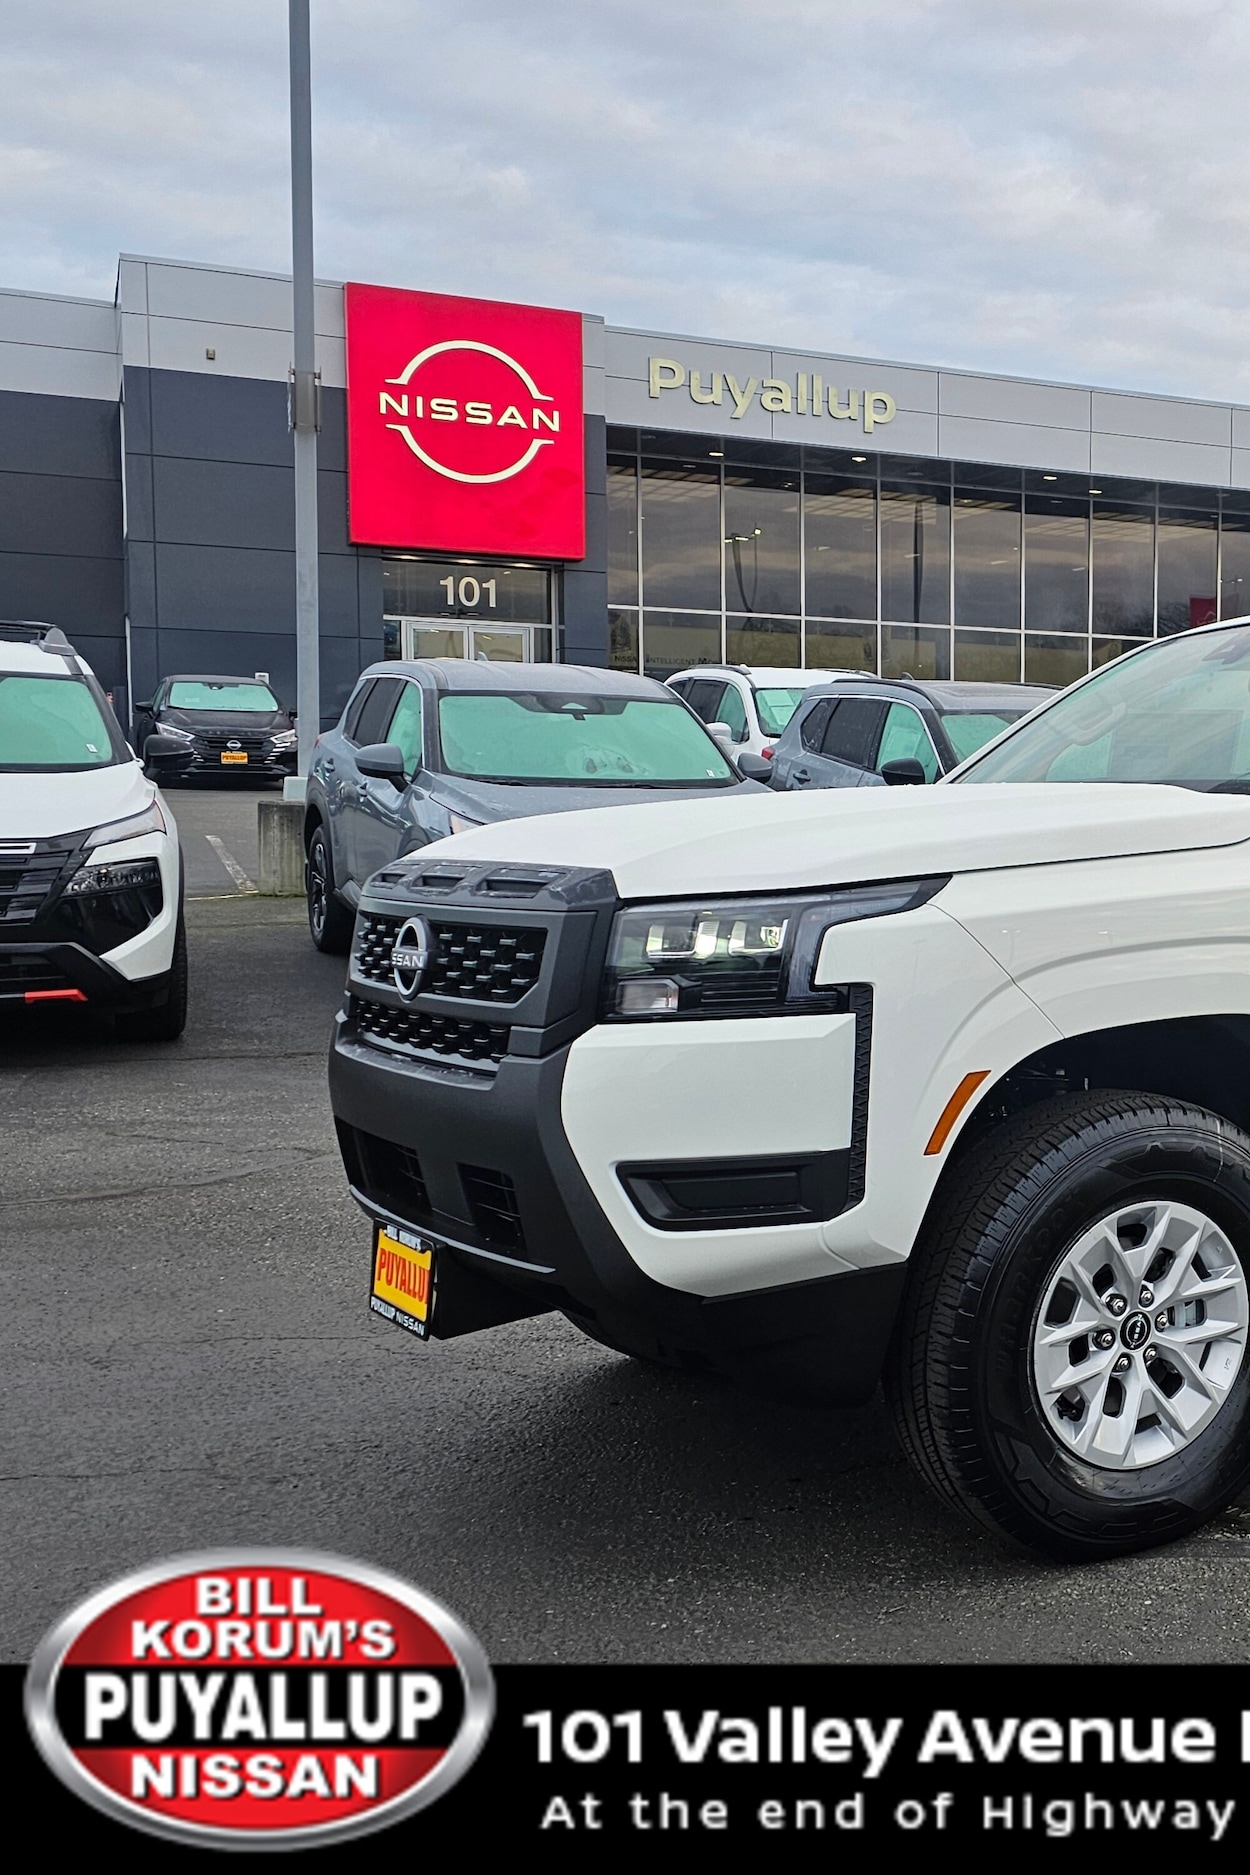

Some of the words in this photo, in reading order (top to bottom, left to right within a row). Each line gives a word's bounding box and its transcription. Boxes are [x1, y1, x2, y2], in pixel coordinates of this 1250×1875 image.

[378, 391, 561, 433] NISSAN
[648, 356, 897, 433] Puyallup
[439, 575, 497, 608] 101
